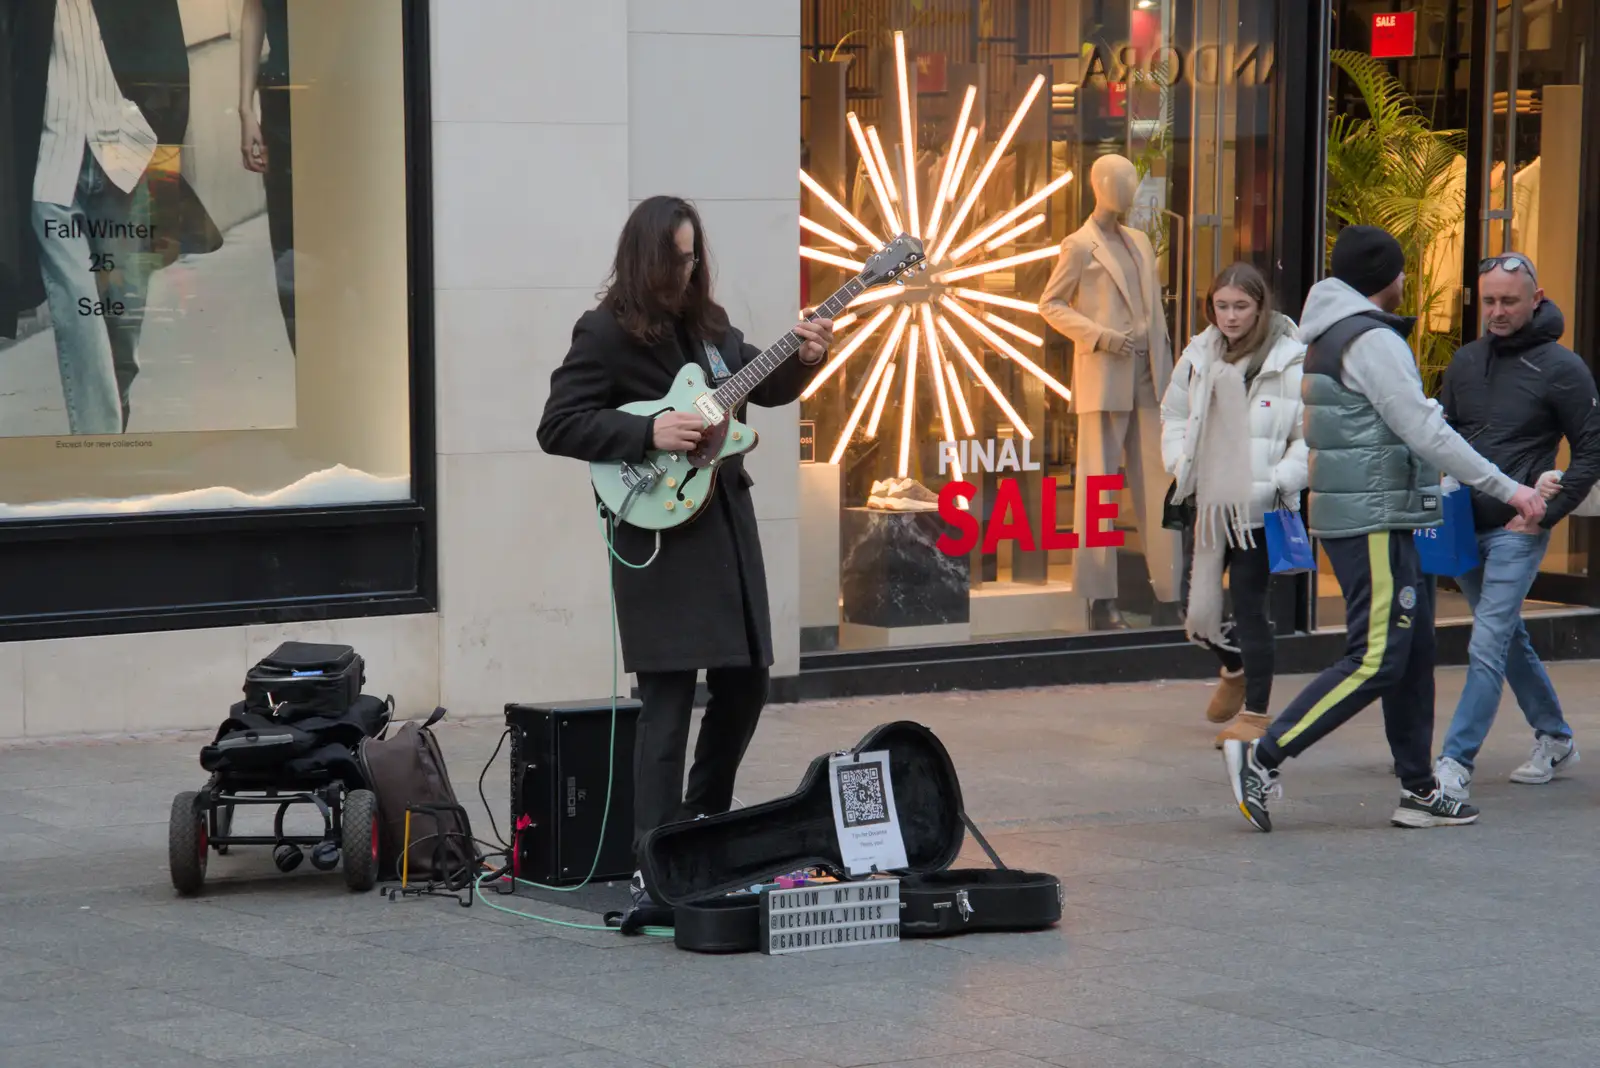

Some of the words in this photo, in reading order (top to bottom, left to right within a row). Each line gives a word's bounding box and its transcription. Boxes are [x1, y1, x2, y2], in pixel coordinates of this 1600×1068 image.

[1375, 15, 1396, 27] SALE
[44, 219, 82, 239] Fall
[87, 219, 157, 239] Winter
[88, 253, 115, 273] 25
[78, 297, 125, 316] Sale
[55, 440, 82, 449] Except
[84, 440, 94, 448] for
[112, 439, 153, 448] collections
[938, 438, 1040, 475] FINAL
[935, 474, 1125, 557] SALE
[772, 891, 819, 909] FOLLOW
[834, 888, 849, 903] MY
[859, 885, 890, 901] BAND
[771, 905, 882, 930] @OCEANNA_VIBES
